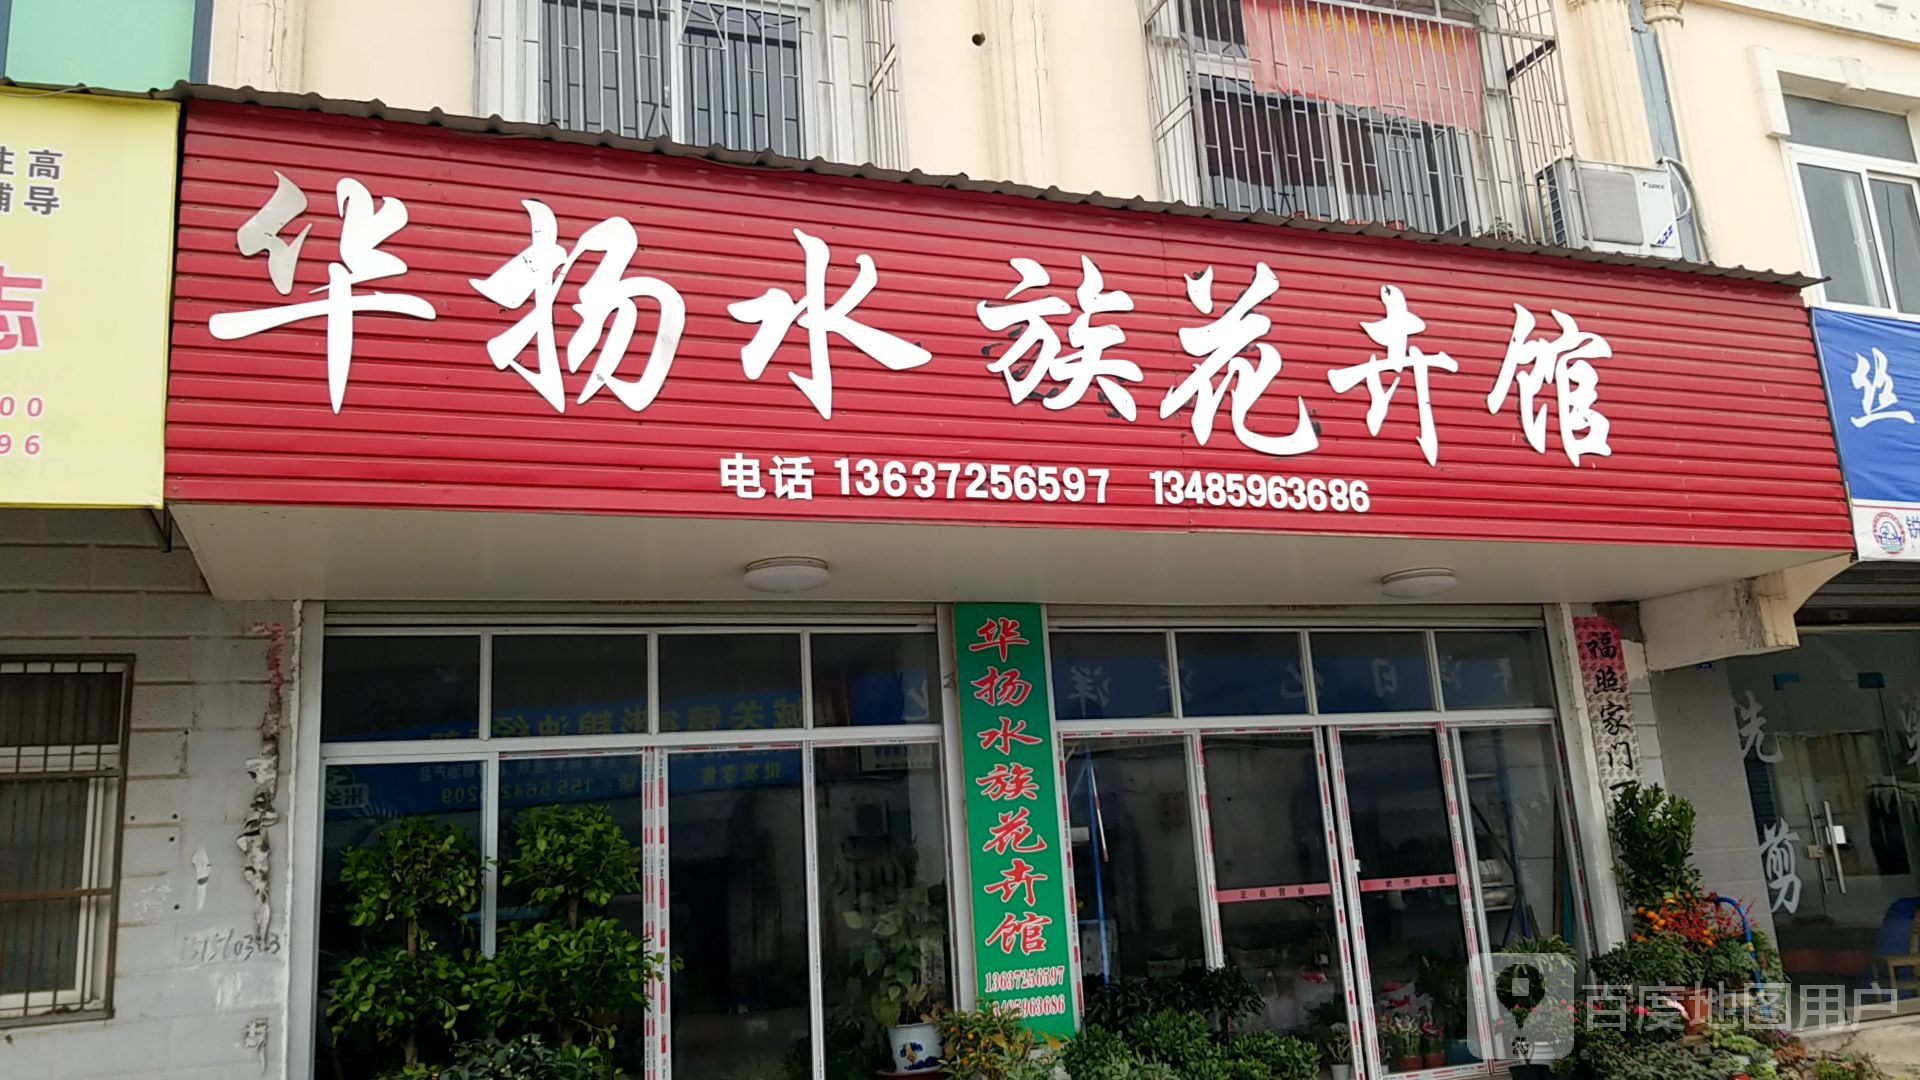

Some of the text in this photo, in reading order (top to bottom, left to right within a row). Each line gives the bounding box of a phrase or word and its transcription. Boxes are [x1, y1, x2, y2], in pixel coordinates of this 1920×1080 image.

[209, 170, 1613, 467] 华扬水族花卉馆
[1851, 347, 1915, 428] 丝
[0, 433, 41, 456] 96
[719, 453, 1370, 513] 电话 13637256597 13485963686
[1585, 632, 1637, 791] 福照家门
[968, 617, 1053, 955] 华扬水族花卉馆
[1240, 886, 1305, 899] 正在营业
[984, 965, 1065, 993] 13637256597
